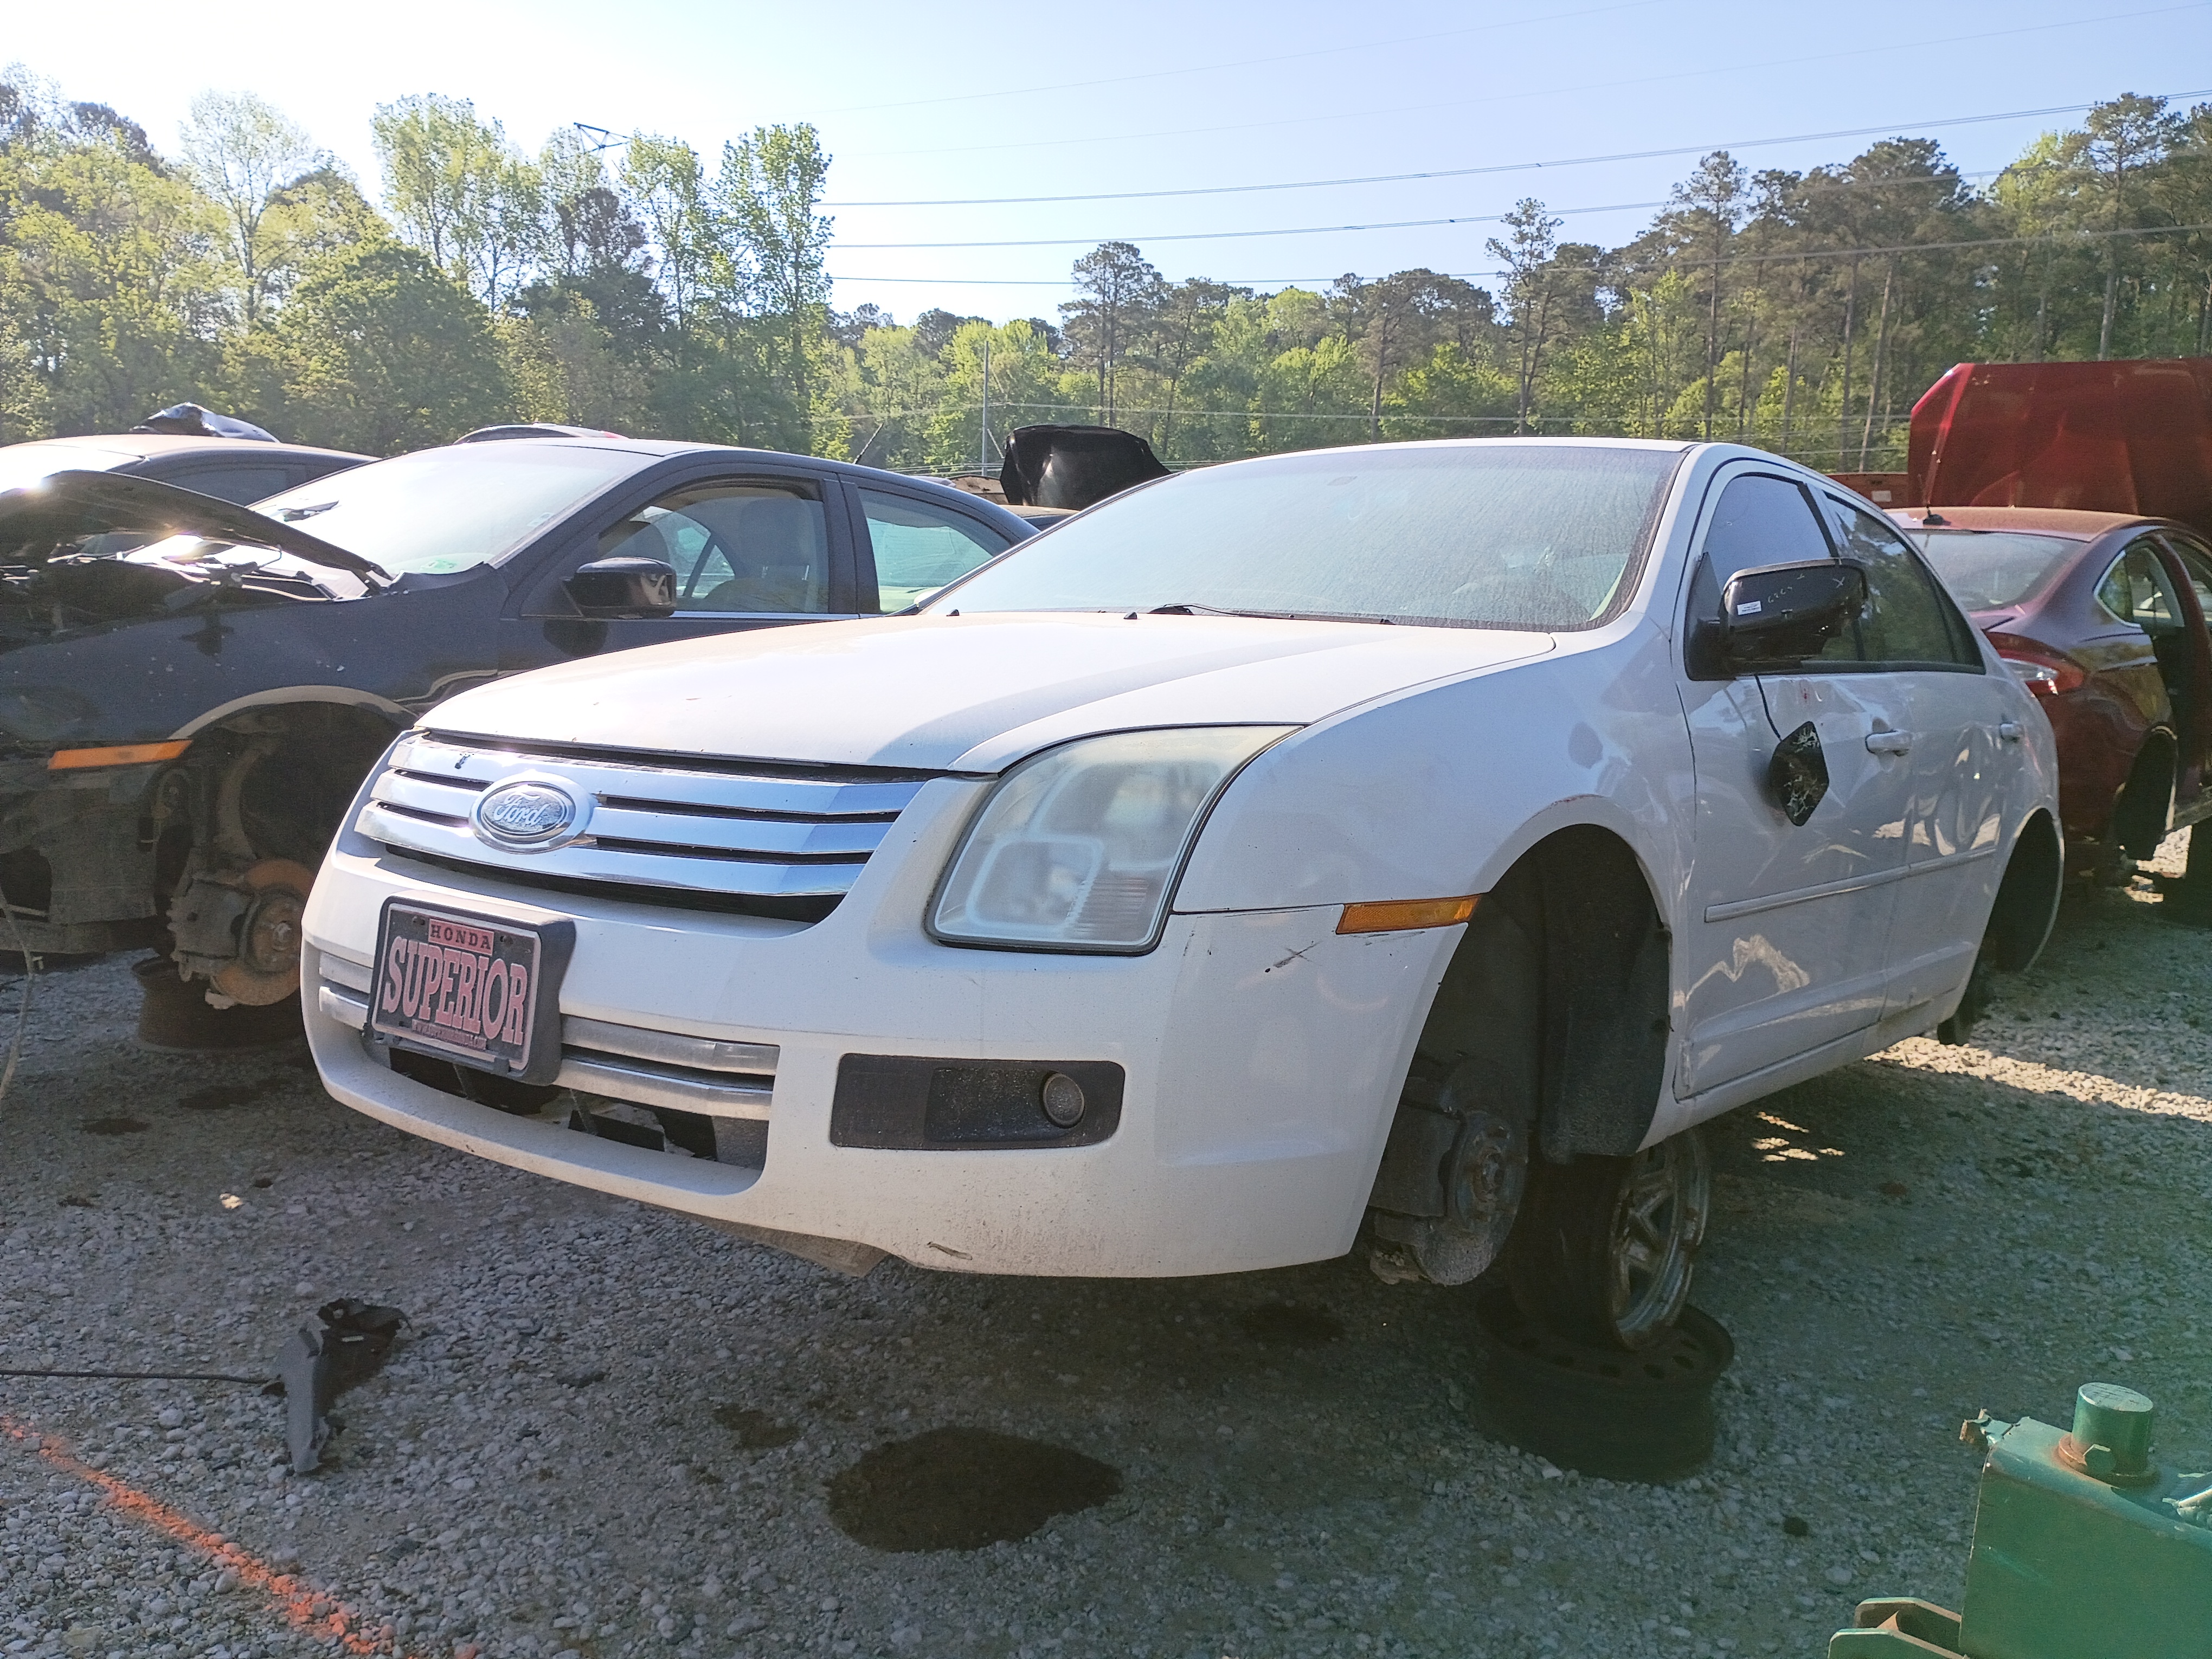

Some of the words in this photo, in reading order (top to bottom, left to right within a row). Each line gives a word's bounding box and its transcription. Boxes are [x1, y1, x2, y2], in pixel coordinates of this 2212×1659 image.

[493, 792, 550, 825] Ford
[430, 924, 492, 950] HONDA
[382, 936, 527, 1045] SUPERIOR
